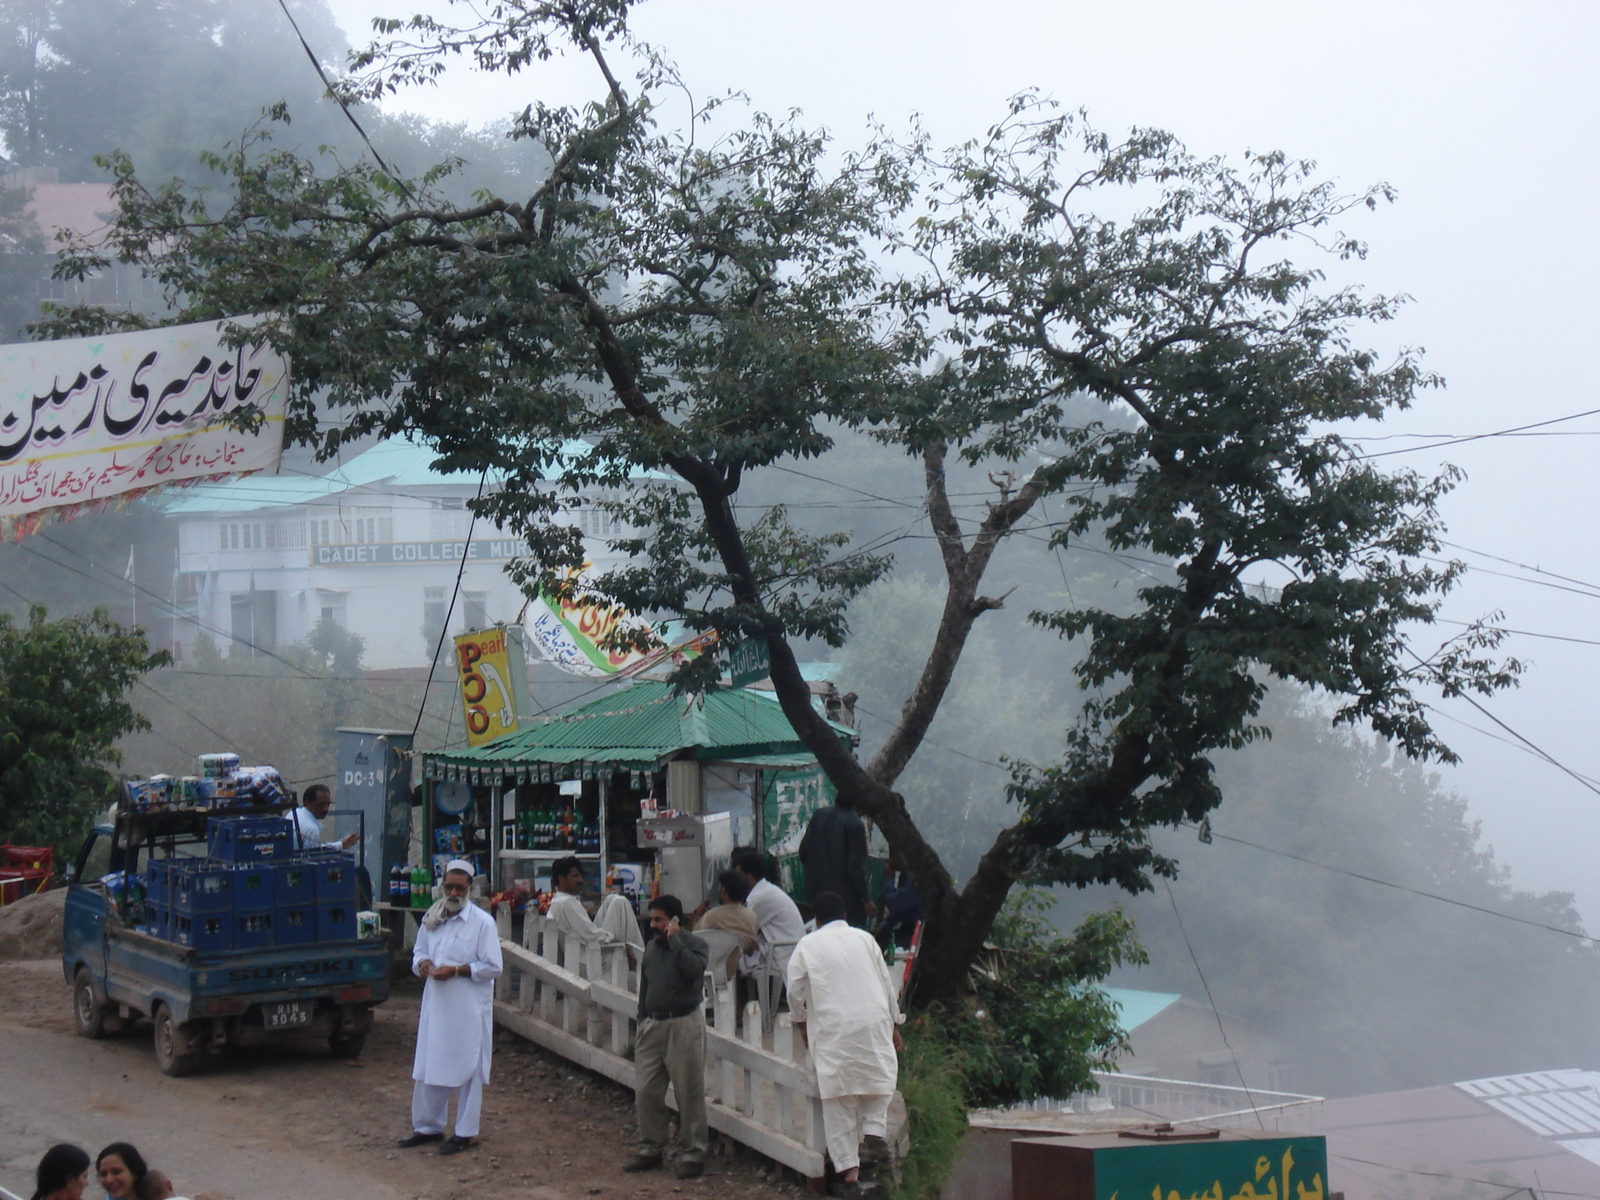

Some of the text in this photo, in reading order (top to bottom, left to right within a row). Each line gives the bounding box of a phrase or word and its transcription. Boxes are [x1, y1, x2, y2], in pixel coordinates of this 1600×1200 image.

[103, 350, 212, 437] میری
[129, 446, 163, 484] محمد
[155, 442, 195, 475] حاجی
[319, 546, 379, 563] CADET
[393, 543, 478, 561] COLLEGE
[228, 959, 355, 981] SUZUKI
